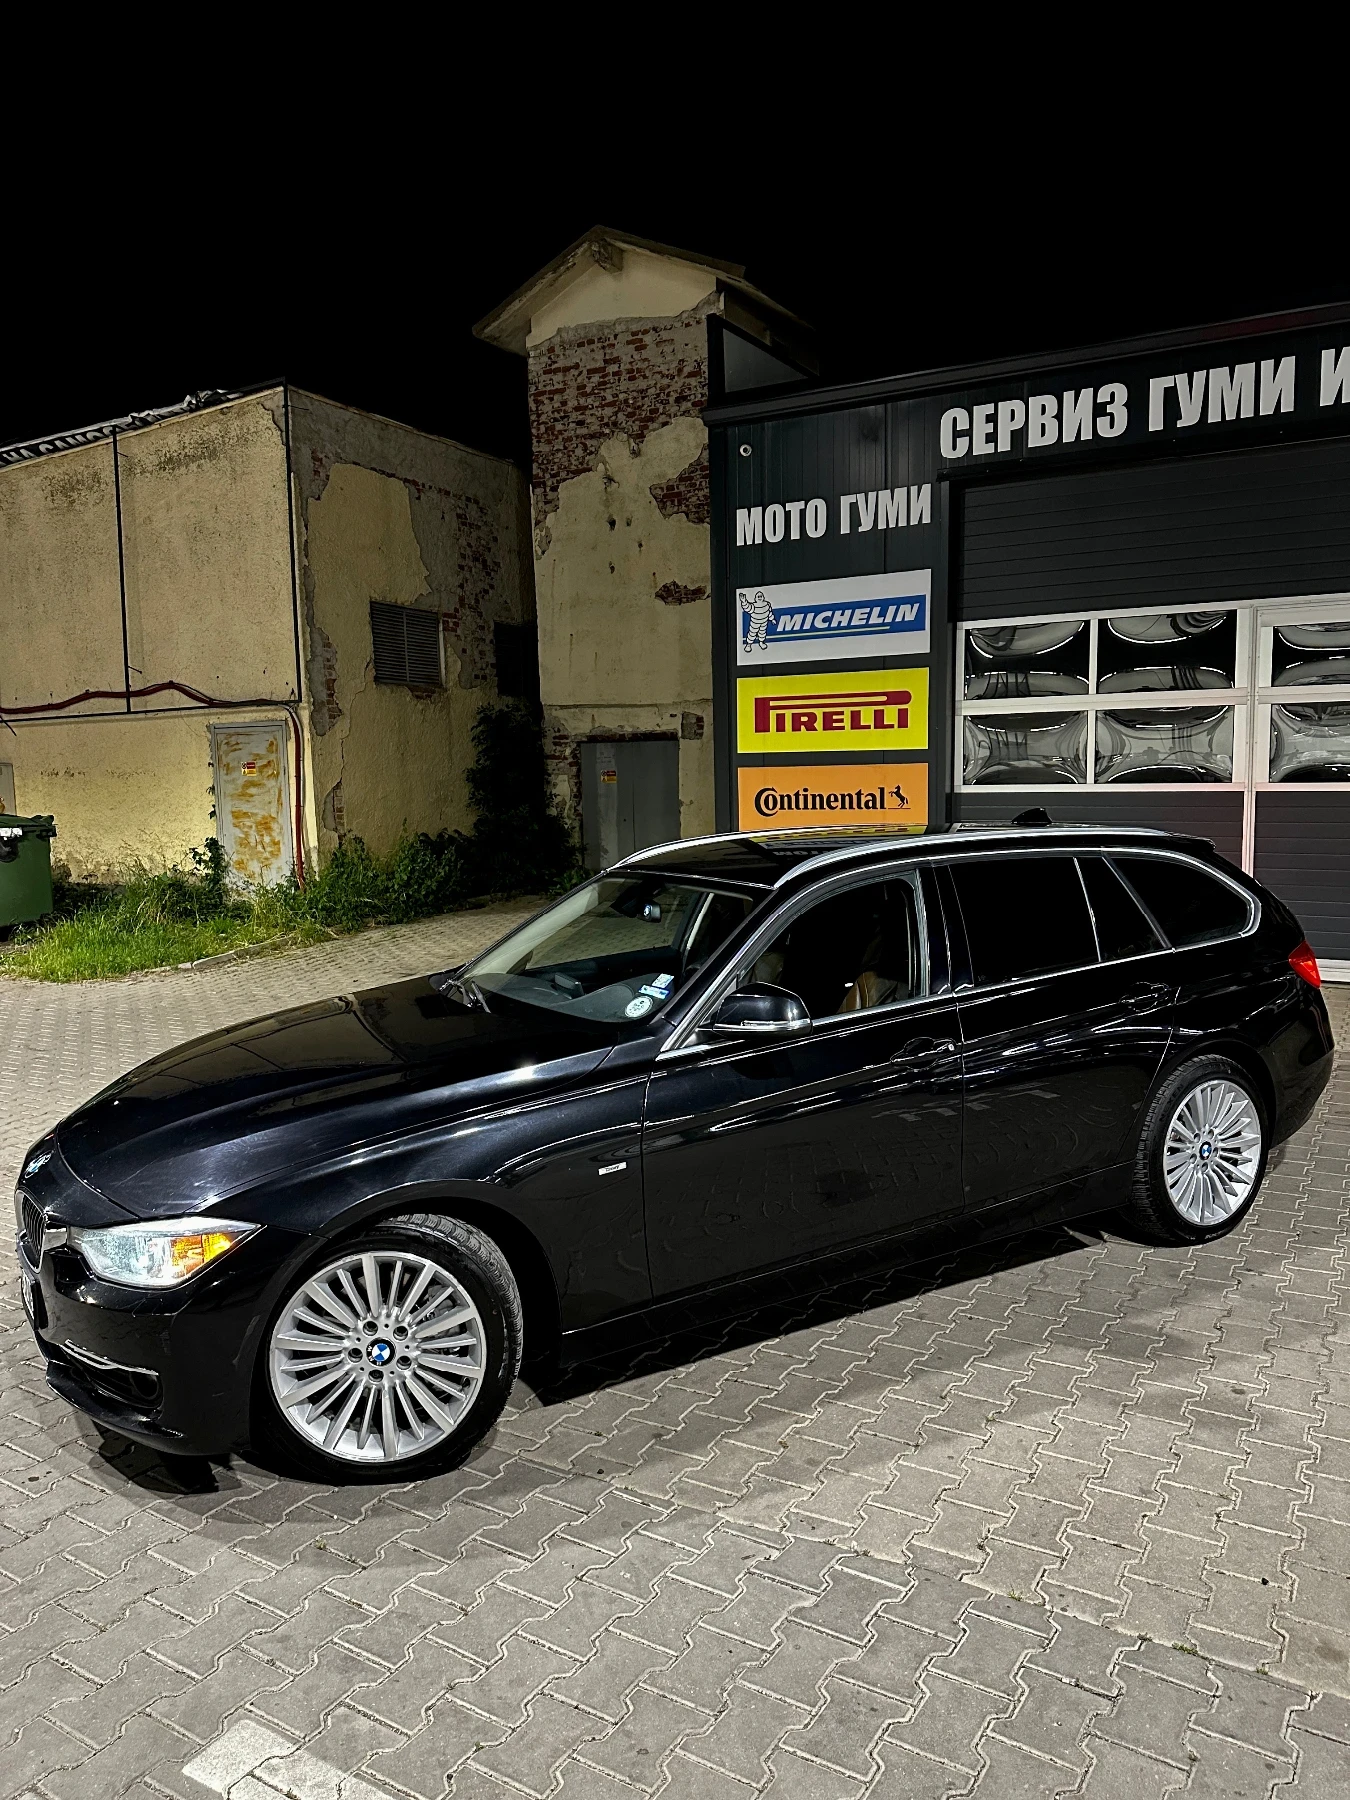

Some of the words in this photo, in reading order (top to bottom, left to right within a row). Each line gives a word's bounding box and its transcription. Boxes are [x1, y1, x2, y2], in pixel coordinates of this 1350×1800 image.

[940, 382, 1128, 459] СЕРВИЗ
[1148, 355, 1296, 432] ГУМИ
[1320, 346, 1350, 407] И
[736, 498, 827, 547] МОТО
[840, 483, 932, 535] ГУМИ
[776, 603, 920, 632] MICHELIN
[754, 690, 912, 733] PIRELLI
[754, 786, 887, 817] Continental
